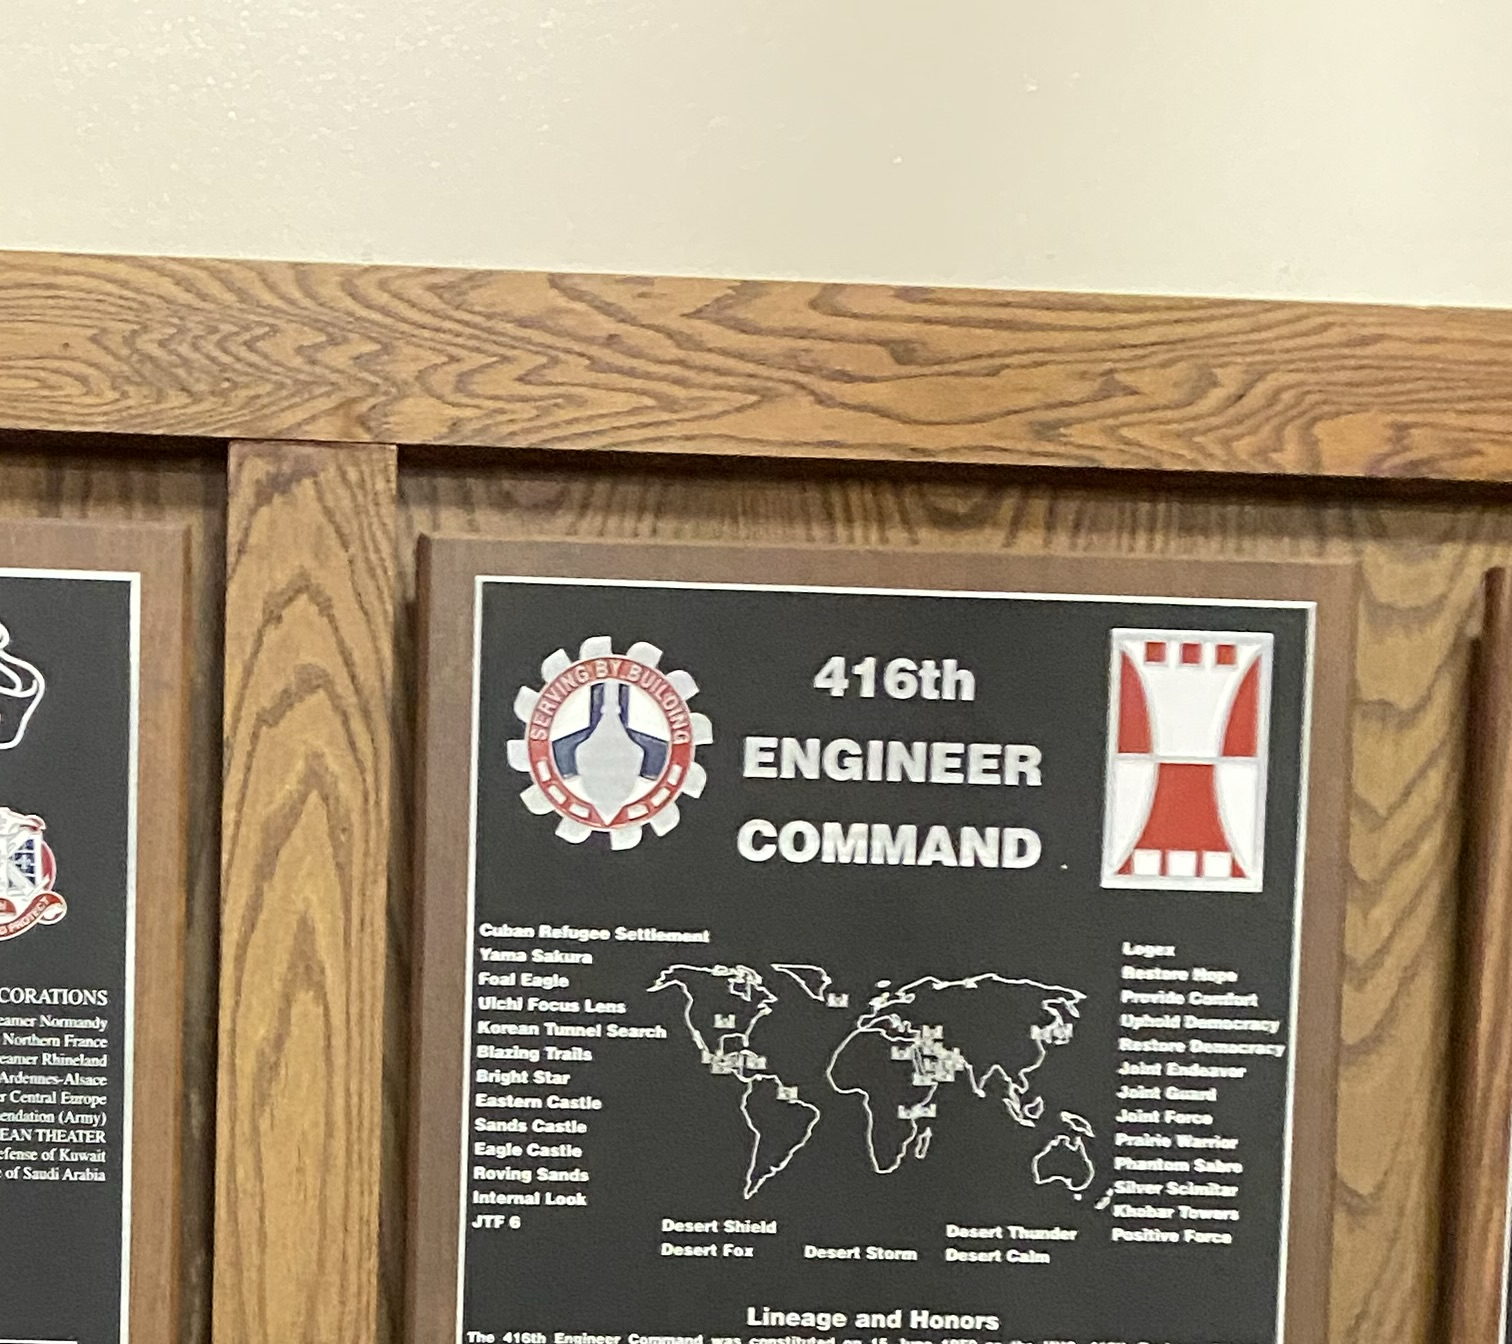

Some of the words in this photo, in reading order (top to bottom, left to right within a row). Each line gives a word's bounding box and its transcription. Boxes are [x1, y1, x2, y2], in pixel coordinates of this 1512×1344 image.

[814, 657, 975, 700] 416th
[531, 665, 590, 741] SERVING
[594, 659, 622, 678] BY
[628, 664, 692, 745] BUILDING
[743, 737, 1042, 786] ENGINEER
[738, 819, 1041, 868] COMMAND
[478, 972, 515, 986] Foal
[521, 973, 569, 990] Eagle
[476, 1069, 528, 1085] Bright
[533, 1070, 570, 1084] Star
[35, 1129, 106, 1143] THEATER
[662, 1219, 718, 1232] Desert
[724, 1220, 776, 1233] Shield
[661, 1243, 717, 1257] Desert
[723, 1244, 753, 1257] Fox
[747, 1307, 847, 1331] Lineage
[855, 1310, 901, 1328] and
[910, 1310, 999, 1330] Honors
